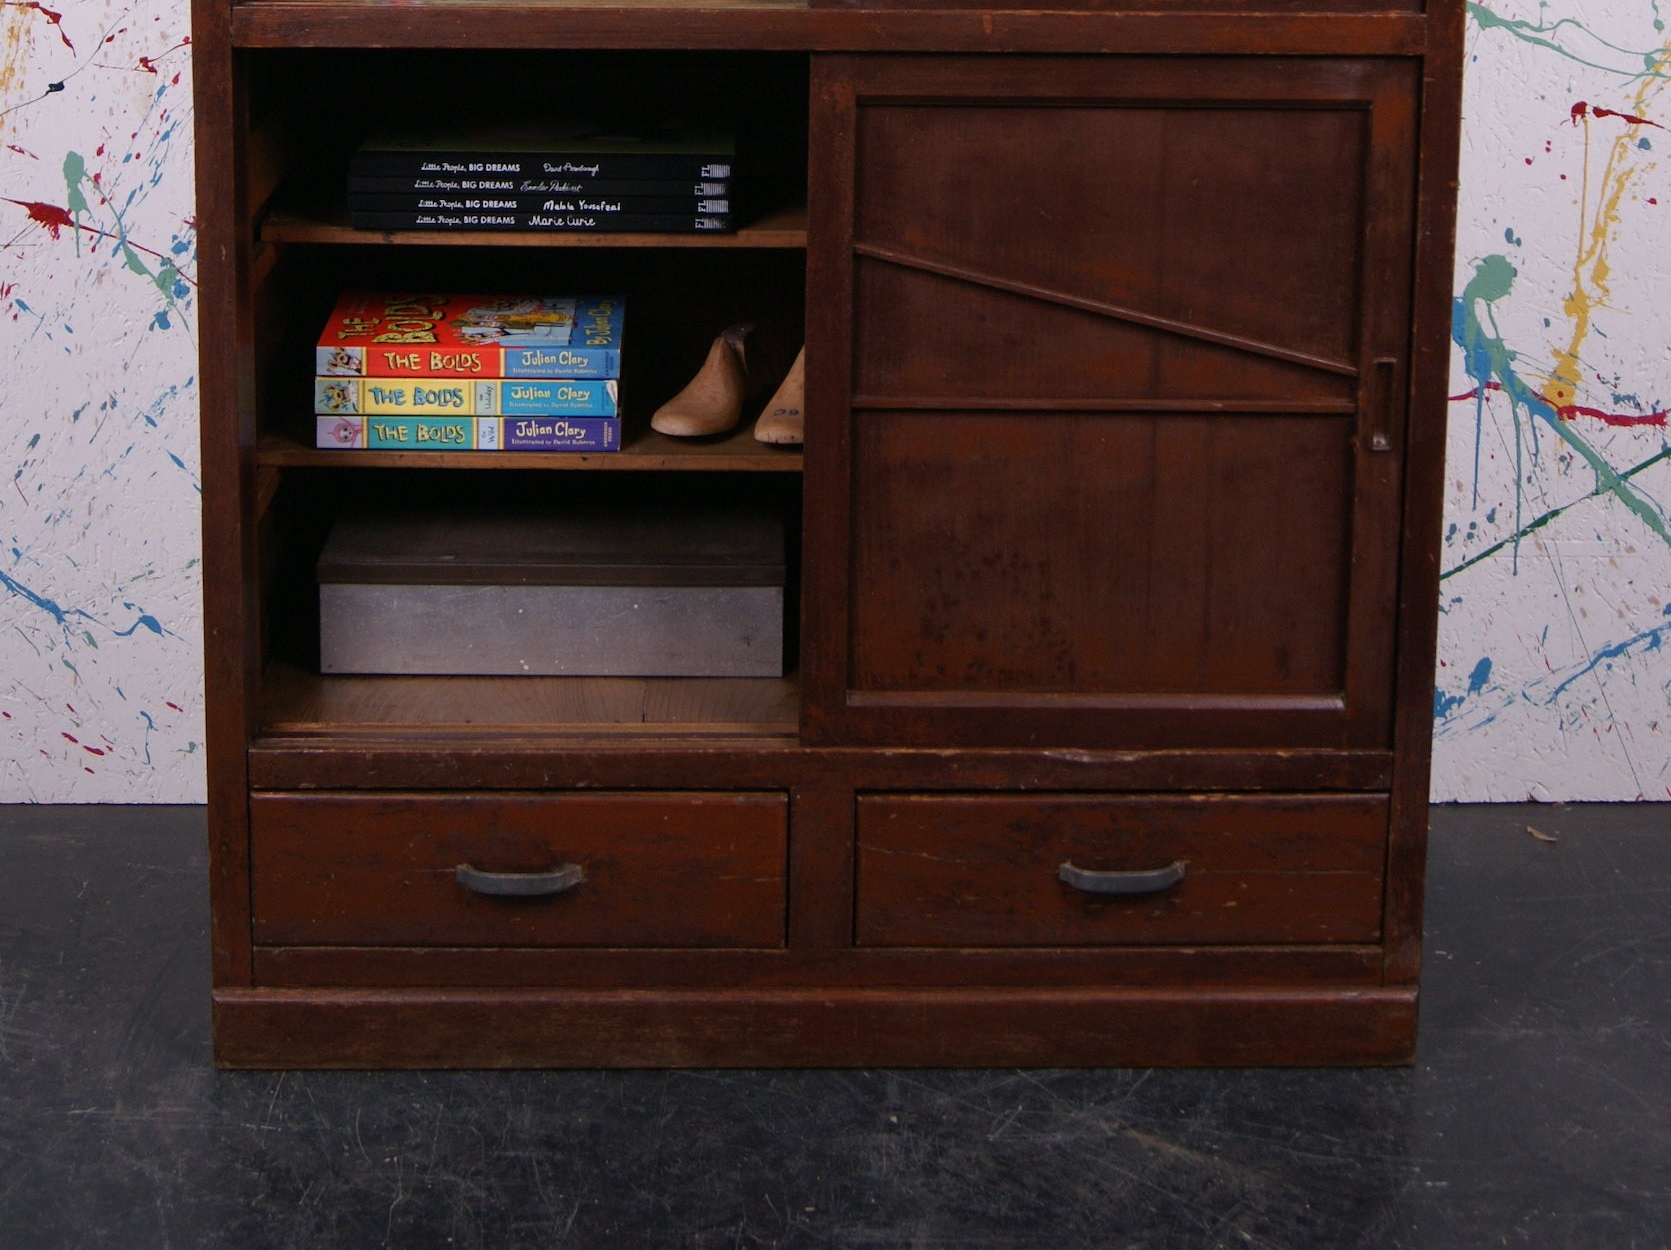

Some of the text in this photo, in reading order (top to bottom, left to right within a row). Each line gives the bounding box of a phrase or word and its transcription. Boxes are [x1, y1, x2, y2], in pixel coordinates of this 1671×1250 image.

[468, 163, 484, 172] BIG
[486, 163, 520, 172] DREAMS
[462, 181, 477, 189] BIG
[479, 181, 514, 189] DREAMS
[465, 200, 481, 208] BIG
[483, 200, 518, 209] DREAMS
[463, 216, 479, 224] BIG
[480, 216, 515, 224] DREAMS
[528, 215, 596, 226] Marie Curie
[337, 318, 380, 340] THE
[384, 351, 482, 373] THE BOLDS
[522, 350, 557, 366] Julian
[559, 351, 589, 367] Clary
[368, 386, 465, 408] THE BOLDS
[511, 386, 551, 400] Julian
[557, 387, 590, 401] Clary
[374, 423, 467, 444] THE BOLDS
[516, 420, 552, 437] Julian
[555, 422, 586, 439] Clary
